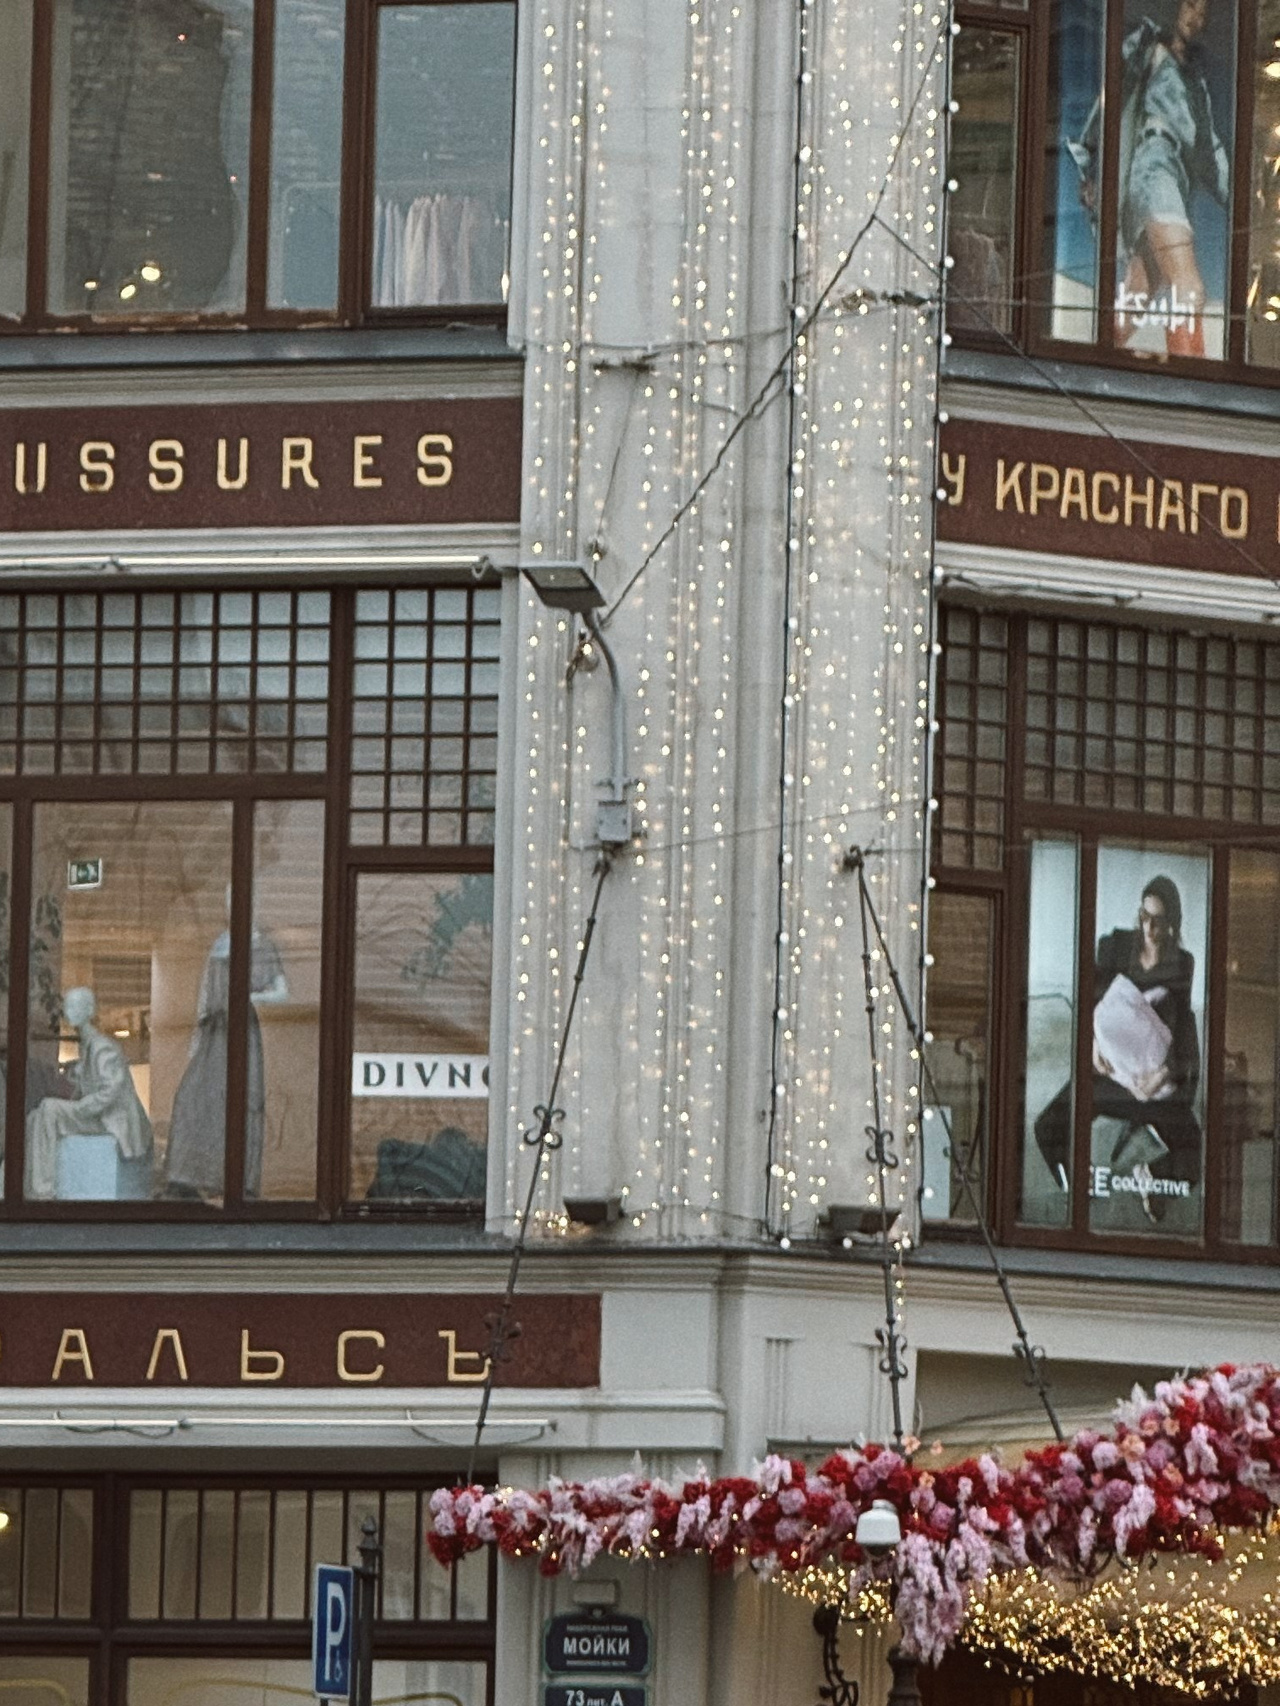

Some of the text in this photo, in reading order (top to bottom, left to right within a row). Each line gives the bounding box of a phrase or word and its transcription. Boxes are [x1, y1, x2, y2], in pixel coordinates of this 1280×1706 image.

[941, 452, 1250, 540] У КРАСНАГО
[1110, 1175, 1191, 1197] COLLECTIVE
[324, 1581, 347, 1682] P
[563, 1634, 630, 1656] МОЙКИ
